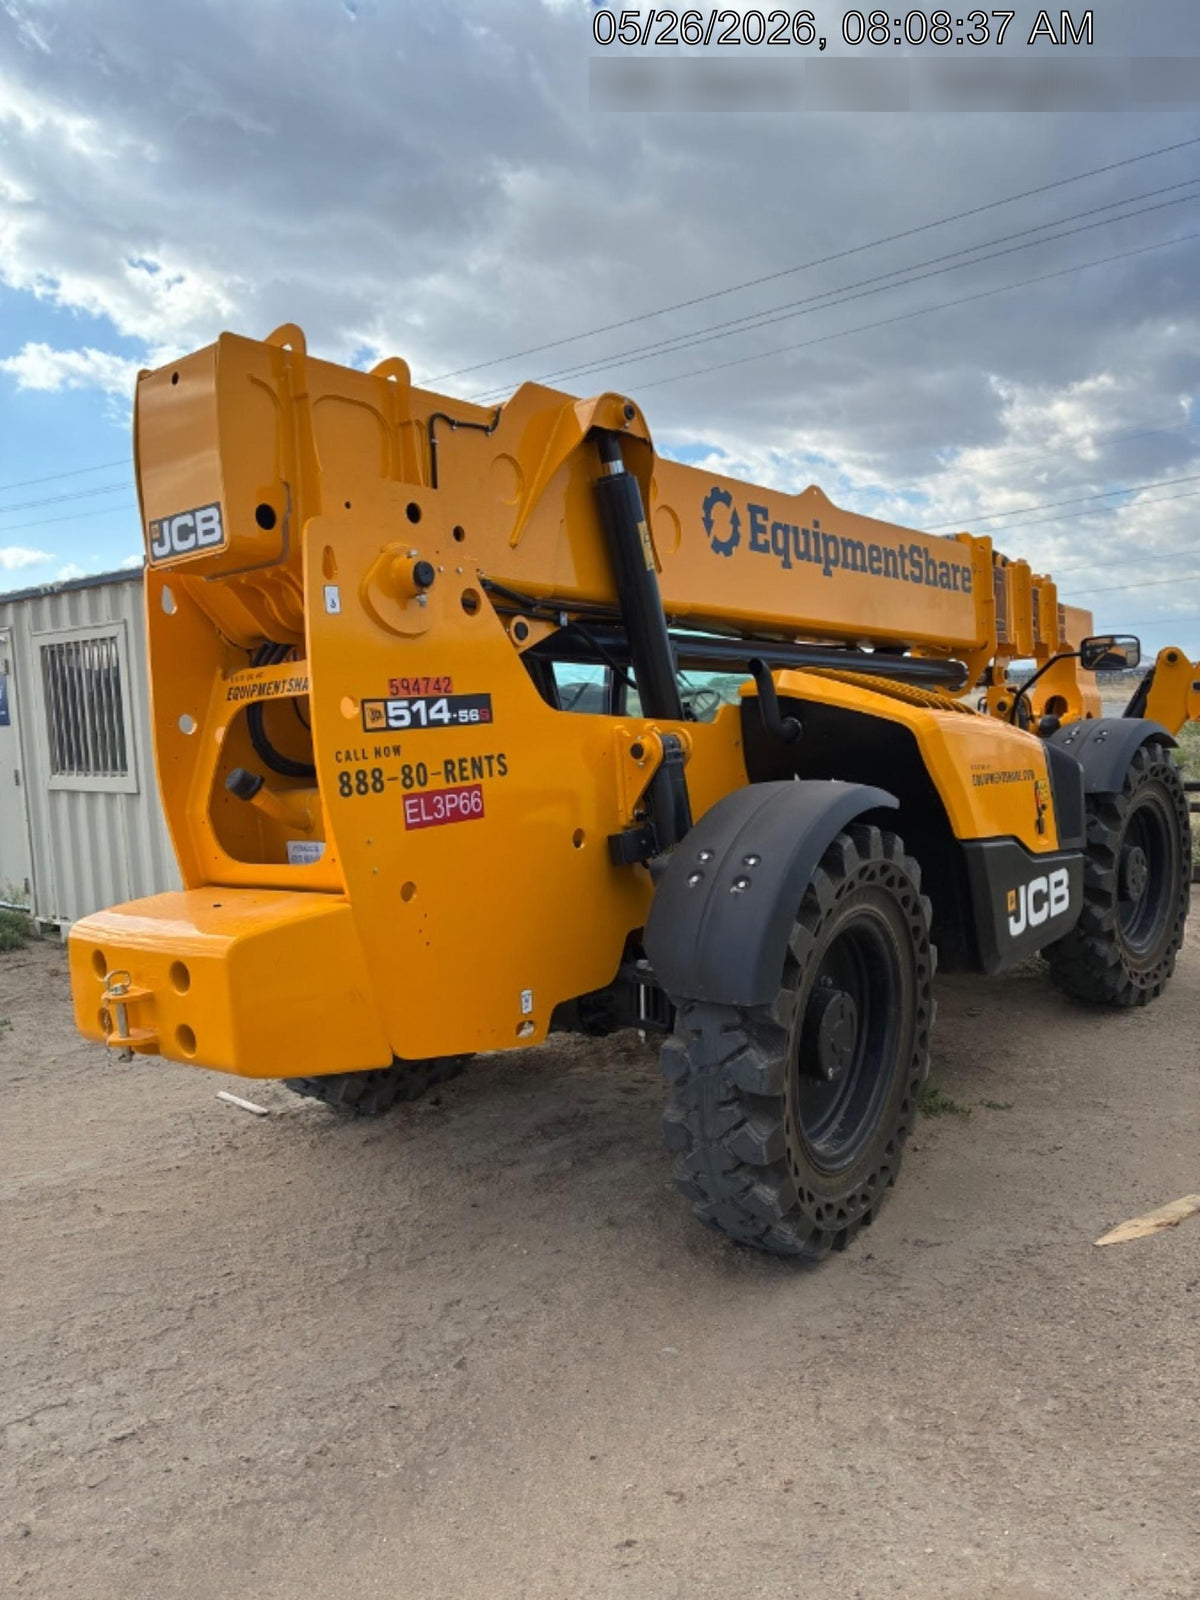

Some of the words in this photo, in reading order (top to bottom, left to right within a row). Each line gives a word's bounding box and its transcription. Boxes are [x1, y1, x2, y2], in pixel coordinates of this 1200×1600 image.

[152, 506, 222, 557] JCB
[747, 502, 972, 594] EquipmentShare
[335, 752, 368, 763] CALL
[374, 745, 402, 758] NOW
[338, 753, 508, 797] 888-80-RENTS
[404, 790, 482, 823] EL3P66
[1009, 867, 1069, 936] JCB
